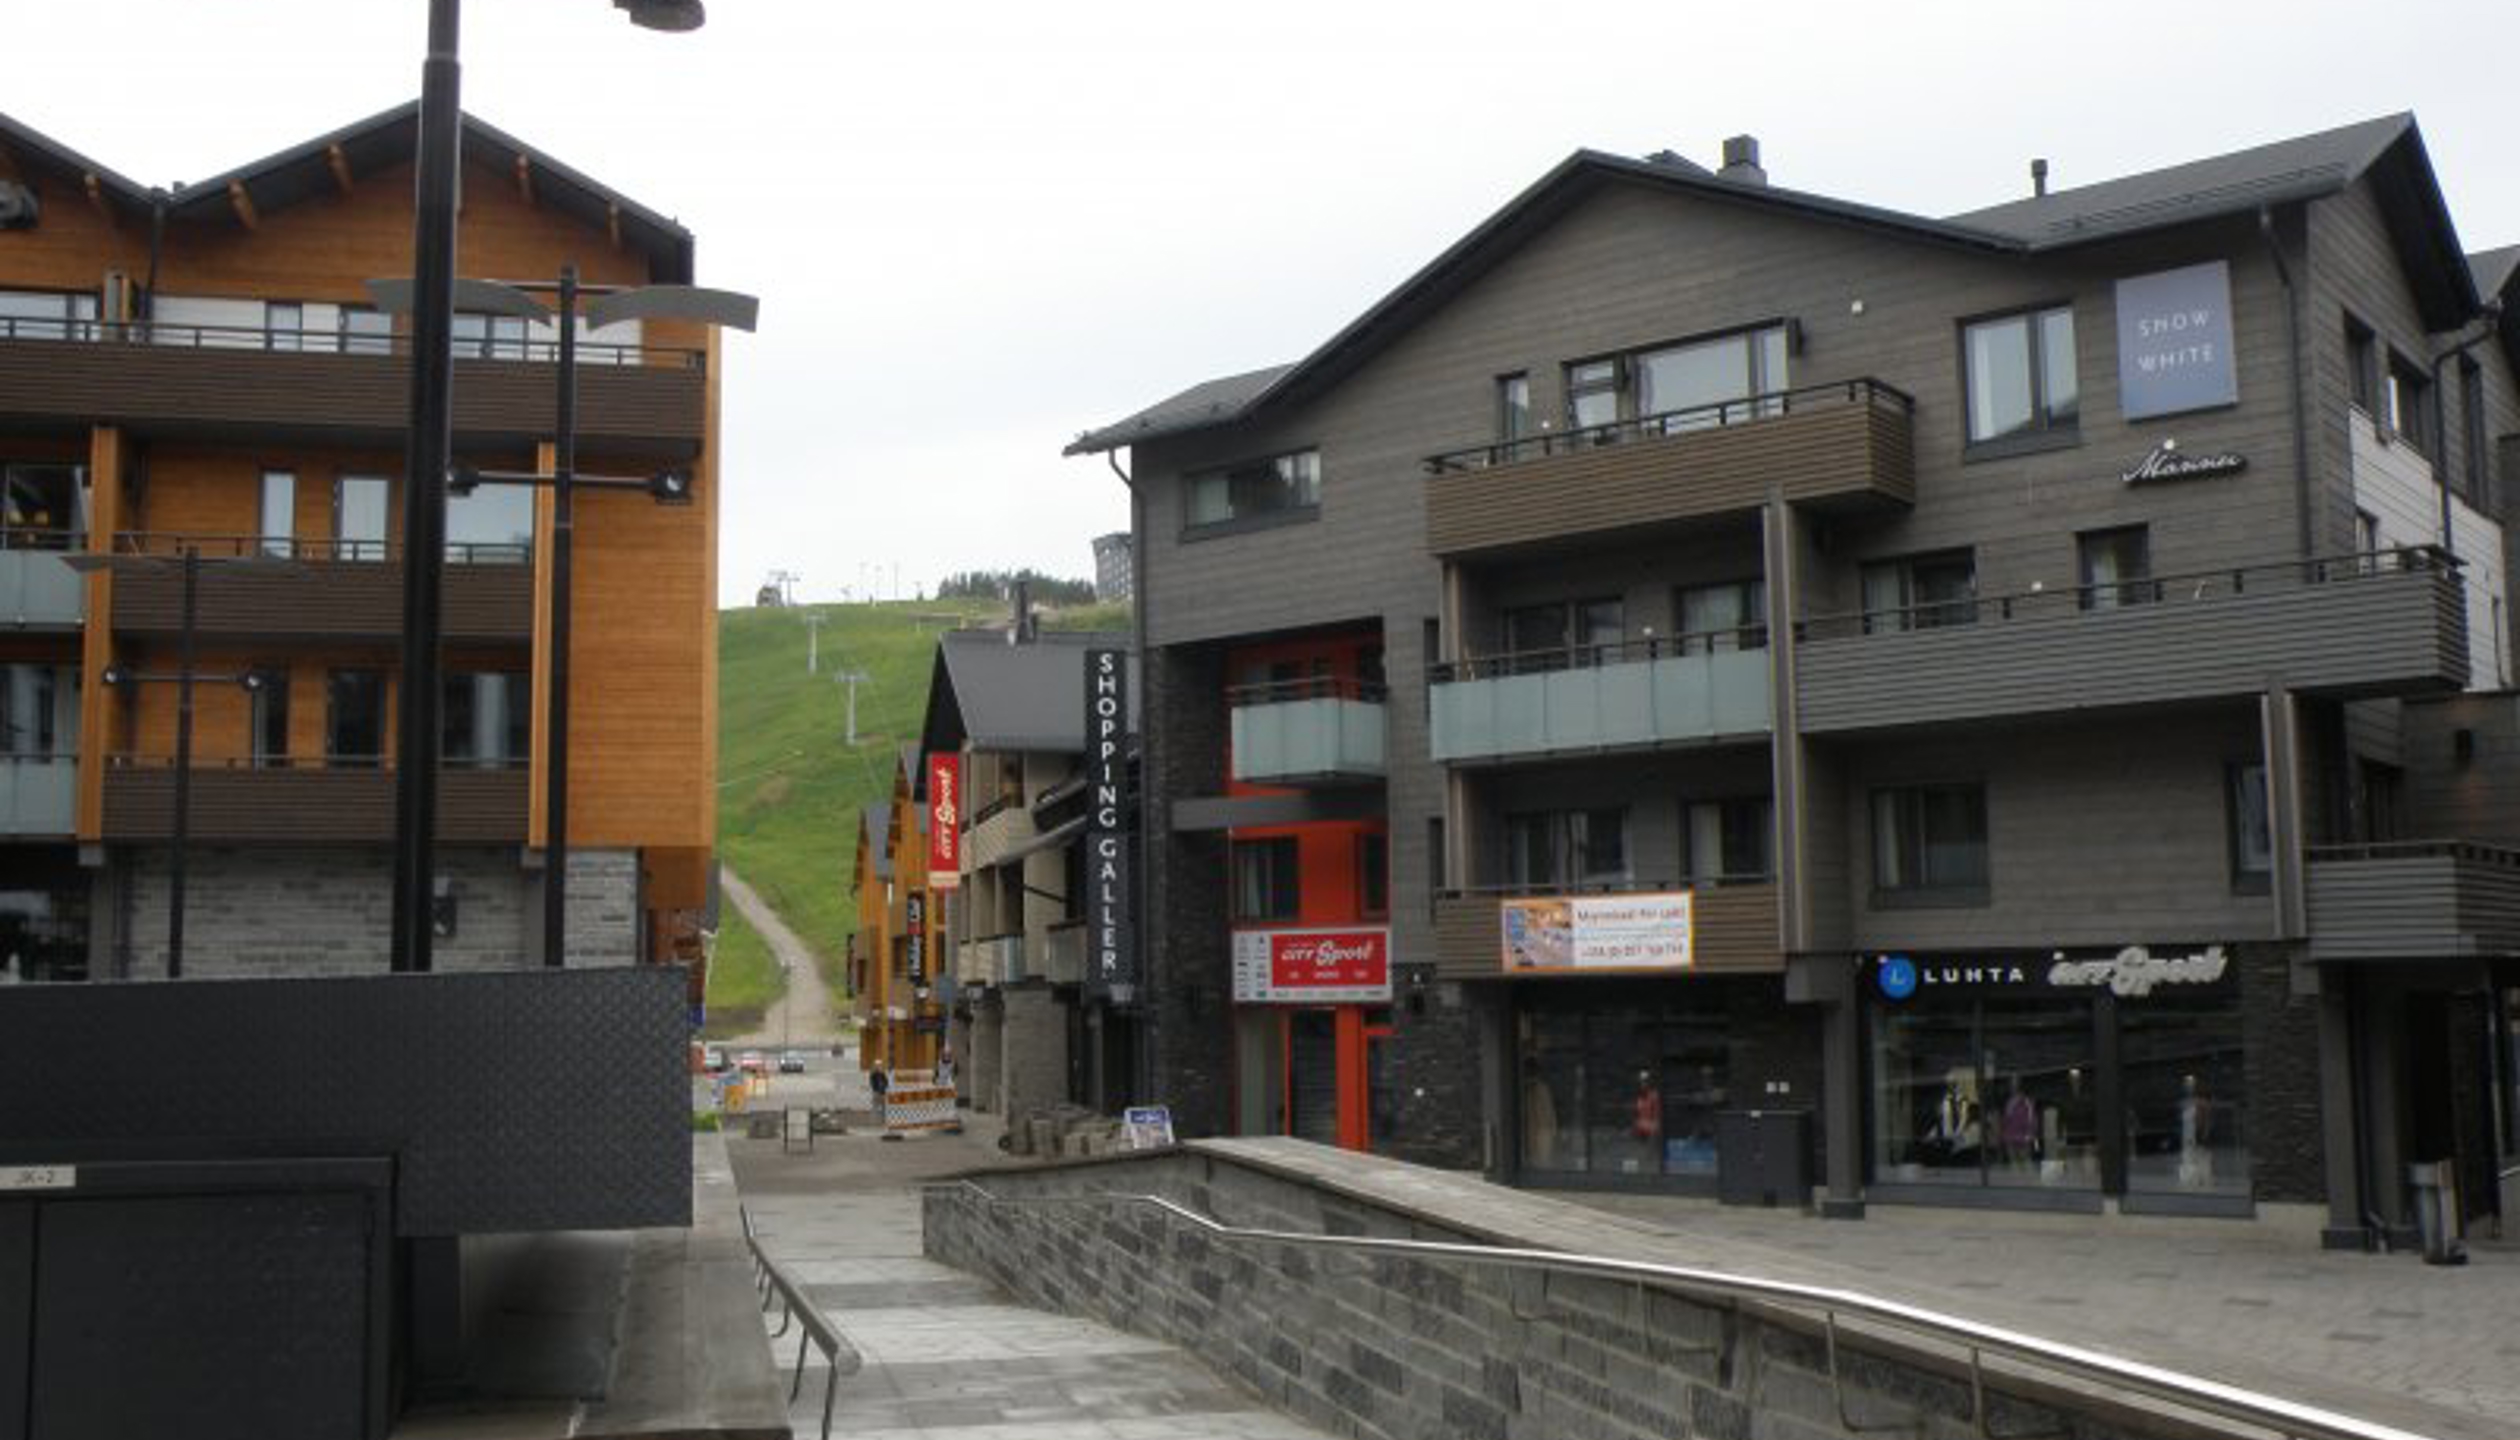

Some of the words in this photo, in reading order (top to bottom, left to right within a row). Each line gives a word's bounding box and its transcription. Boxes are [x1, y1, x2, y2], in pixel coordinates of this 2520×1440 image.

[2137, 311, 2209, 338] SNOW
[2137, 345, 2214, 372] WHITE
[1097, 652, 1117, 828] SHOPPING
[1098, 838, 1117, 979] GALLER
[1923, 966, 2025, 984] LUHTA
